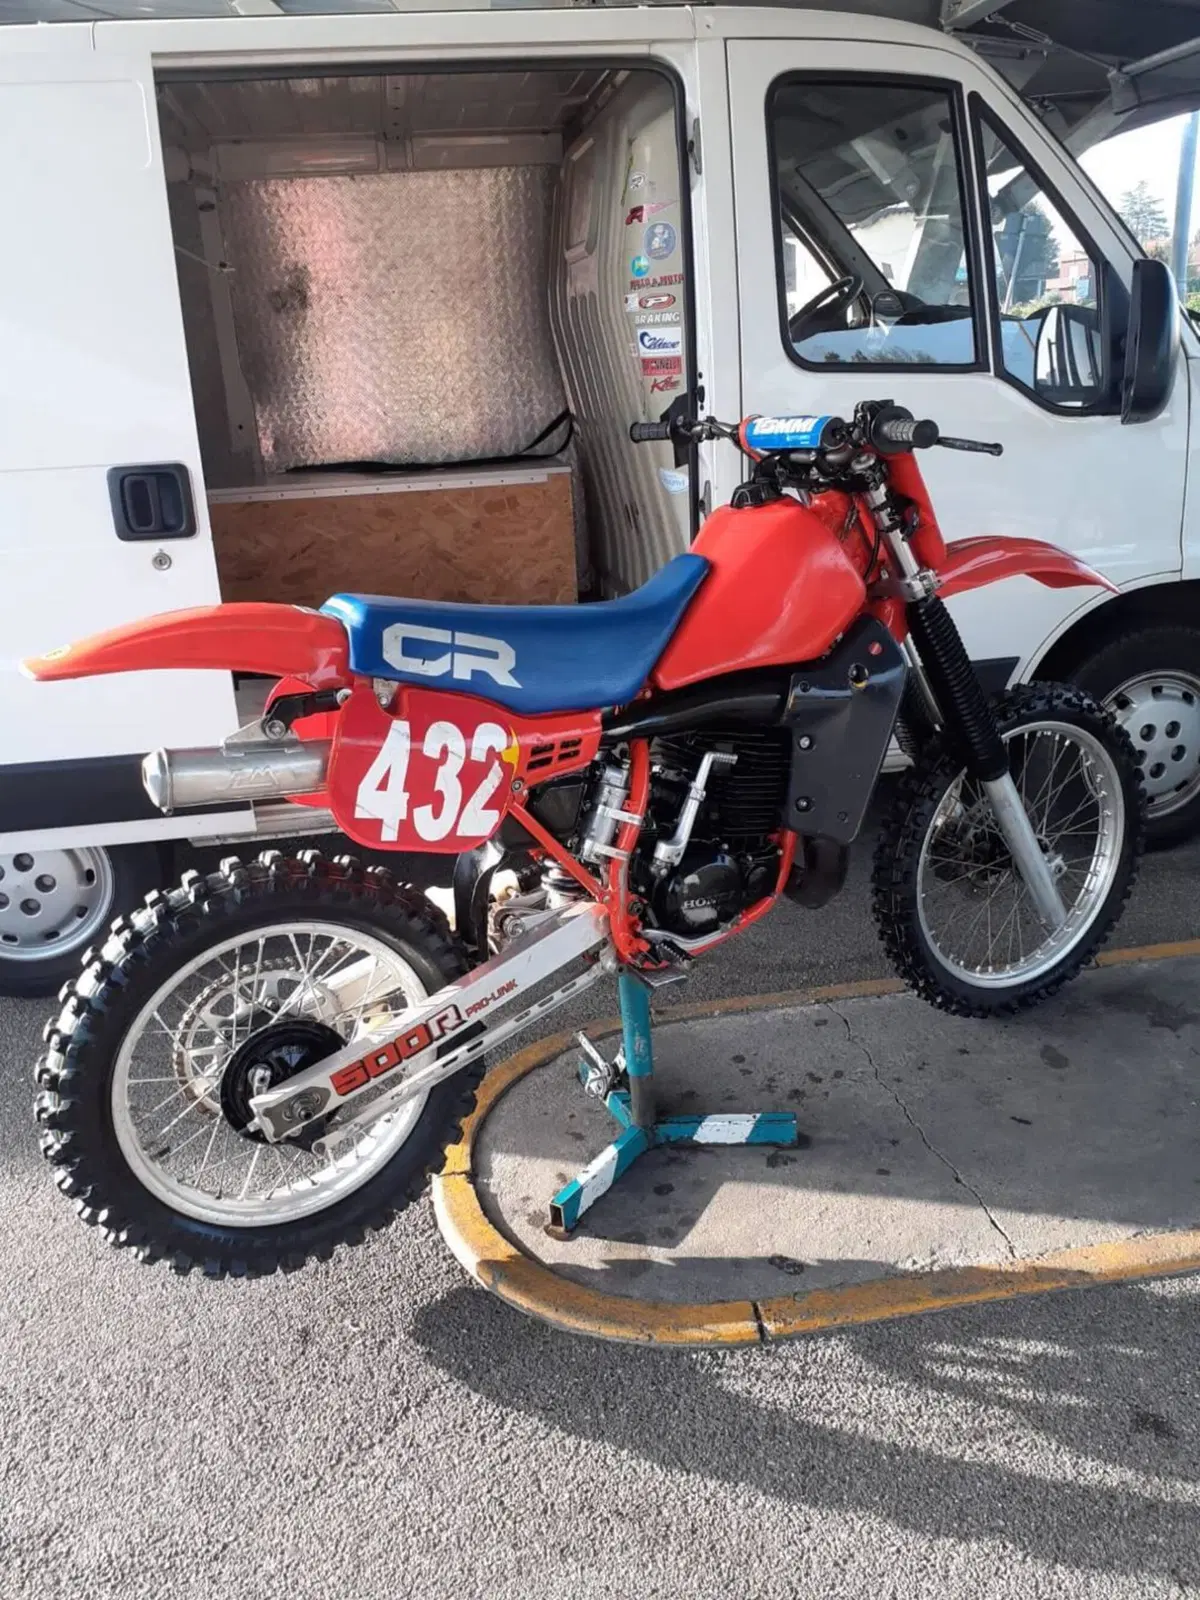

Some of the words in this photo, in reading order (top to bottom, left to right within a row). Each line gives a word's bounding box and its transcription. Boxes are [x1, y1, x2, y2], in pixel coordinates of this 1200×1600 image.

[634, 312, 680, 325] BRAKING
[382, 622, 523, 689] CR
[354, 718, 508, 843] 432
[329, 1003, 468, 1096] 500R
[465, 978, 518, 1018] PRO-LINK
